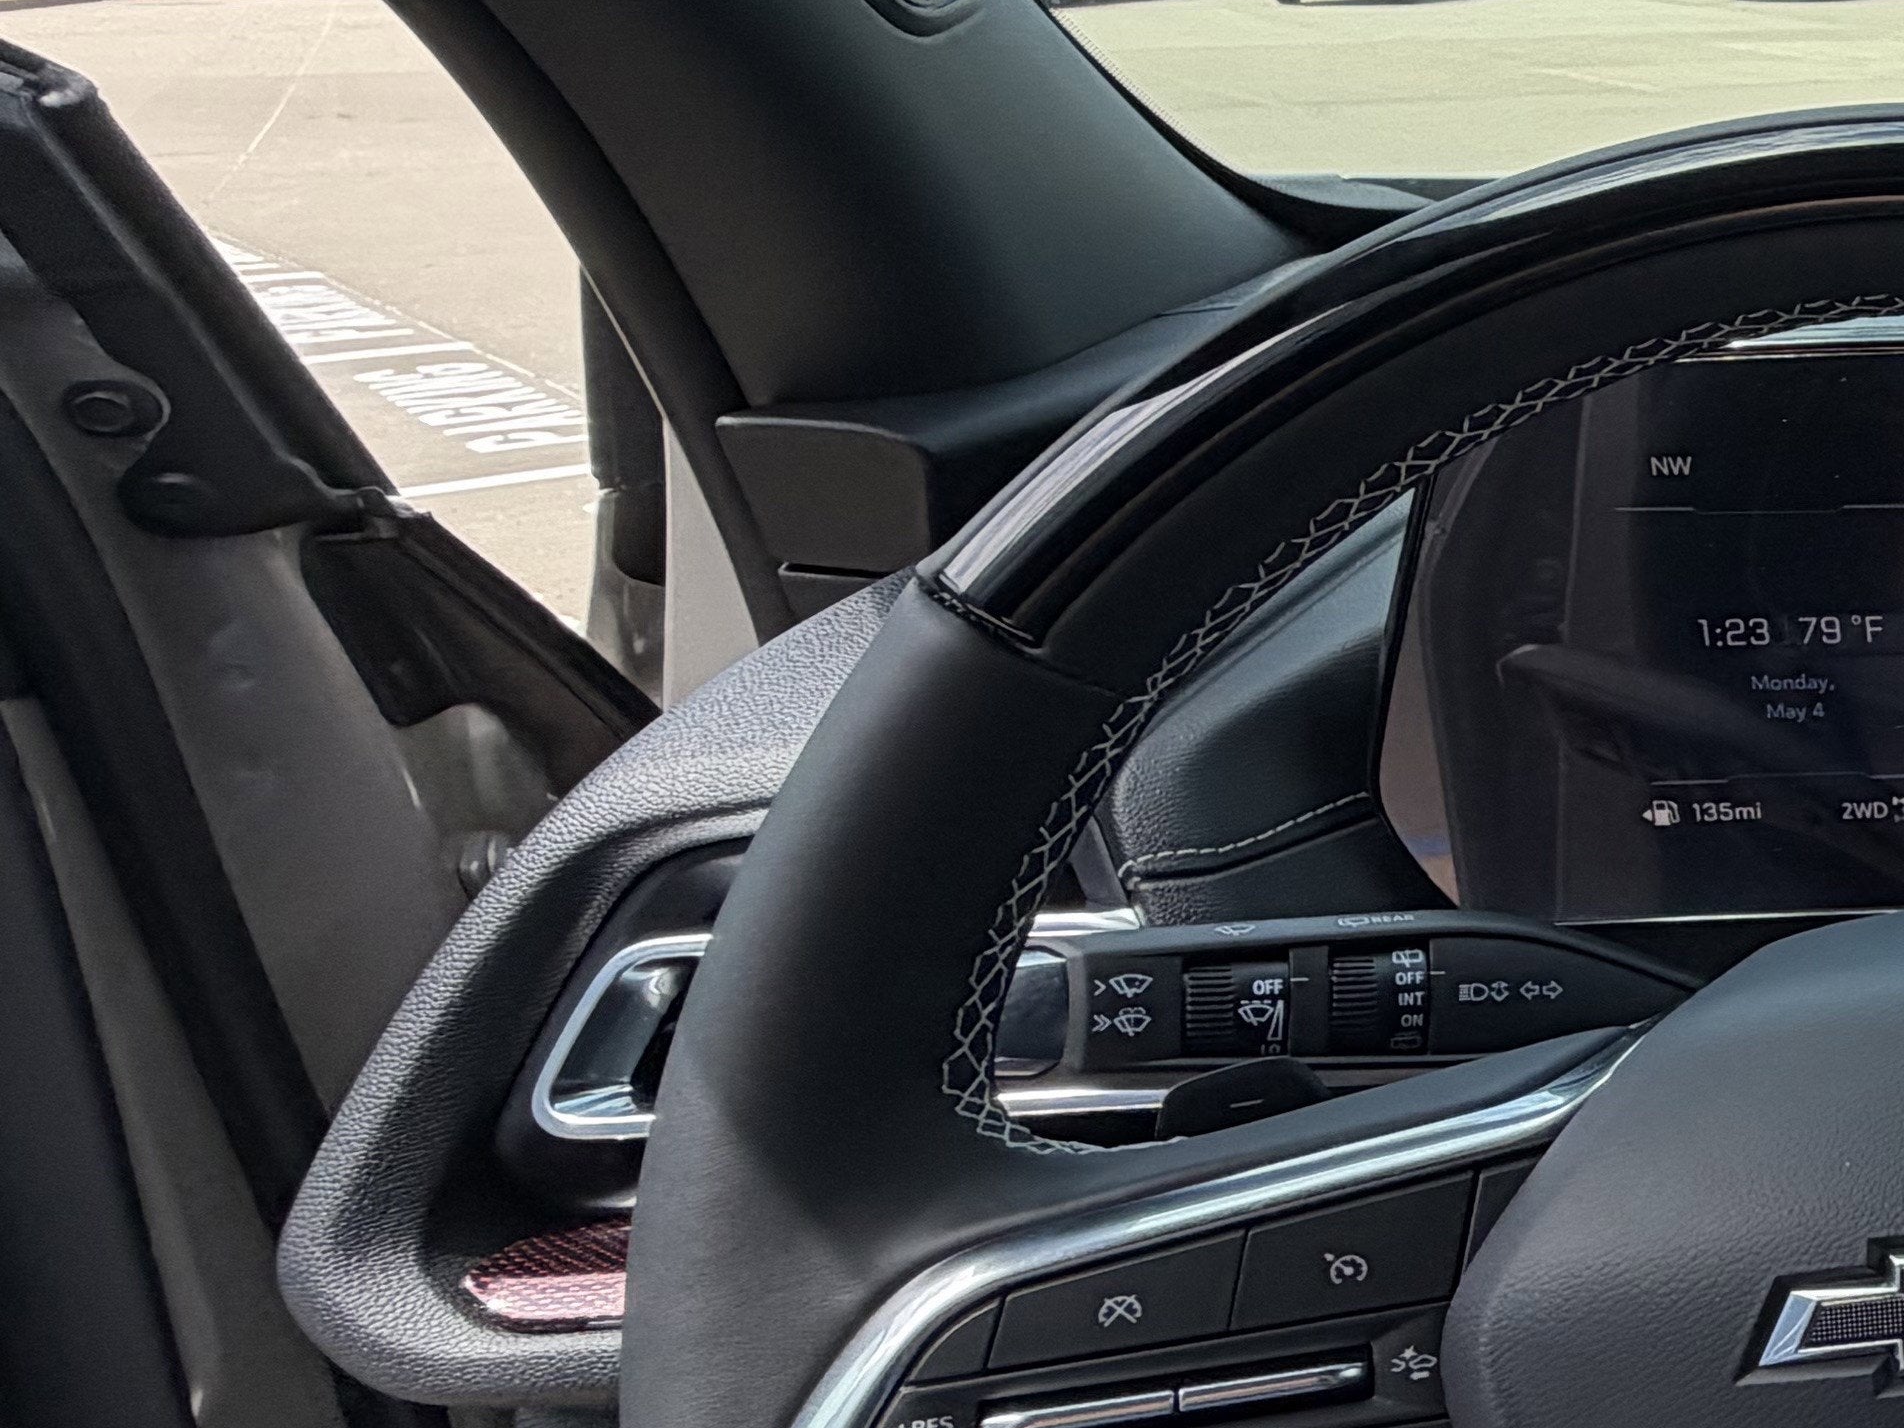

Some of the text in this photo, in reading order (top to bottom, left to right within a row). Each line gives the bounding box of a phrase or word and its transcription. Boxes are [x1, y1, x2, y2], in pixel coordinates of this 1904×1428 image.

[1650, 456, 1692, 476] NW
[1697, 617, 1771, 647] 1:23
[1750, 673, 1836, 694] Monday,
[1766, 702, 1826, 723] May 4
[1691, 801, 1763, 822] 135mi
[1841, 802, 1888, 820] 2WD
[1252, 978, 1283, 996] OFF
[1395, 970, 1425, 985] OFF
[1398, 992, 1425, 1006] INT
[1400, 1013, 1424, 1028] ON
